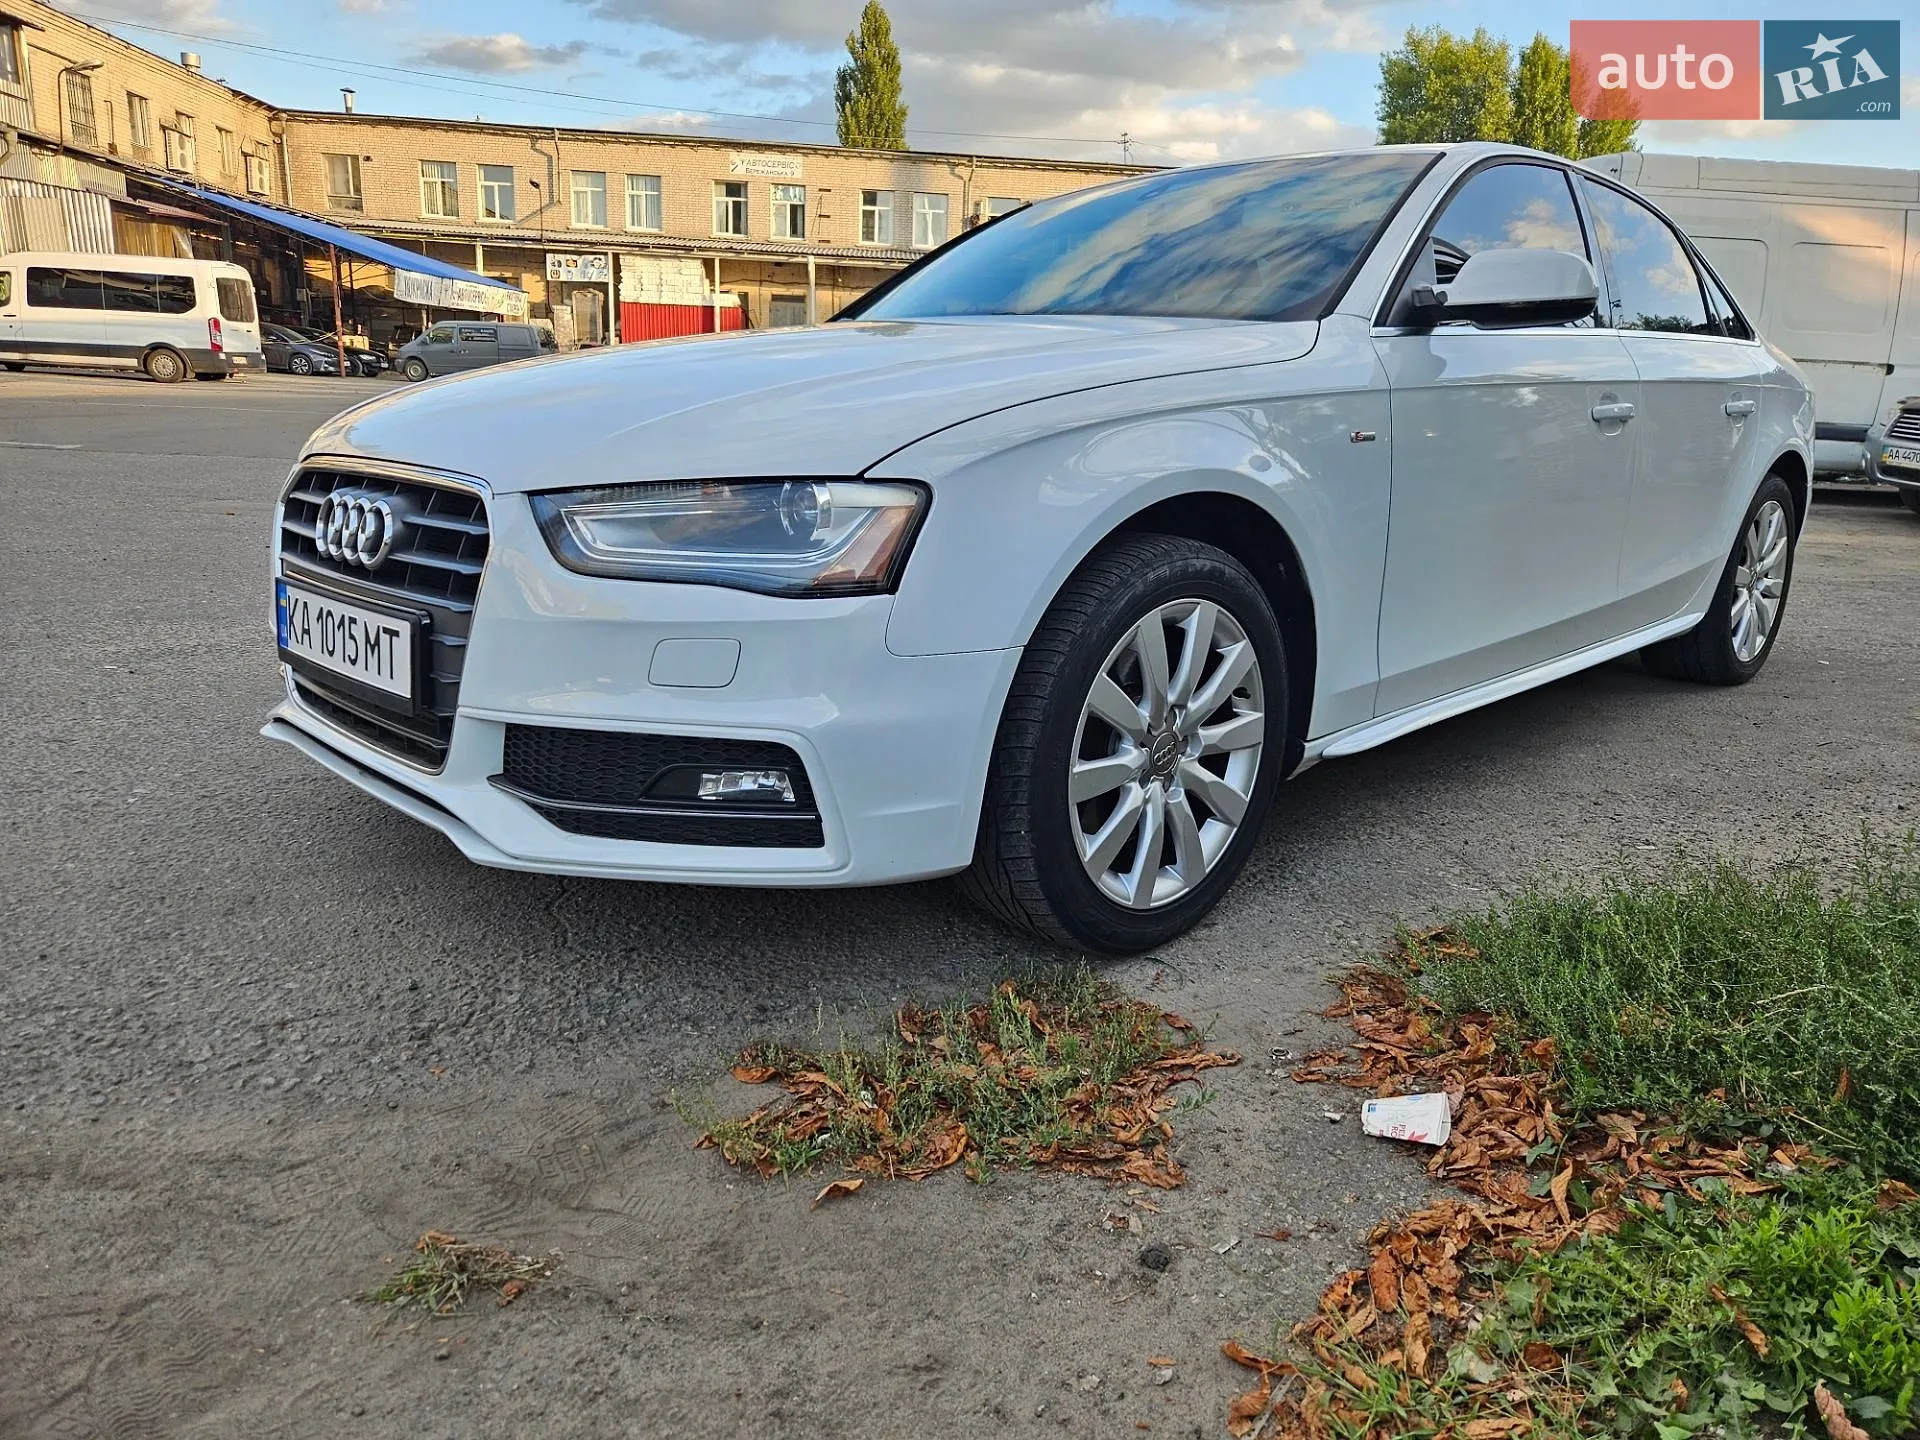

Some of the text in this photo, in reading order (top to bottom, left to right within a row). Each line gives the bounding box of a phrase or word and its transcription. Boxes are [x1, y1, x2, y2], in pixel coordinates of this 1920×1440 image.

[1888, 449, 1900, 461] AA
[288, 594, 400, 680] KA 1015 MT
